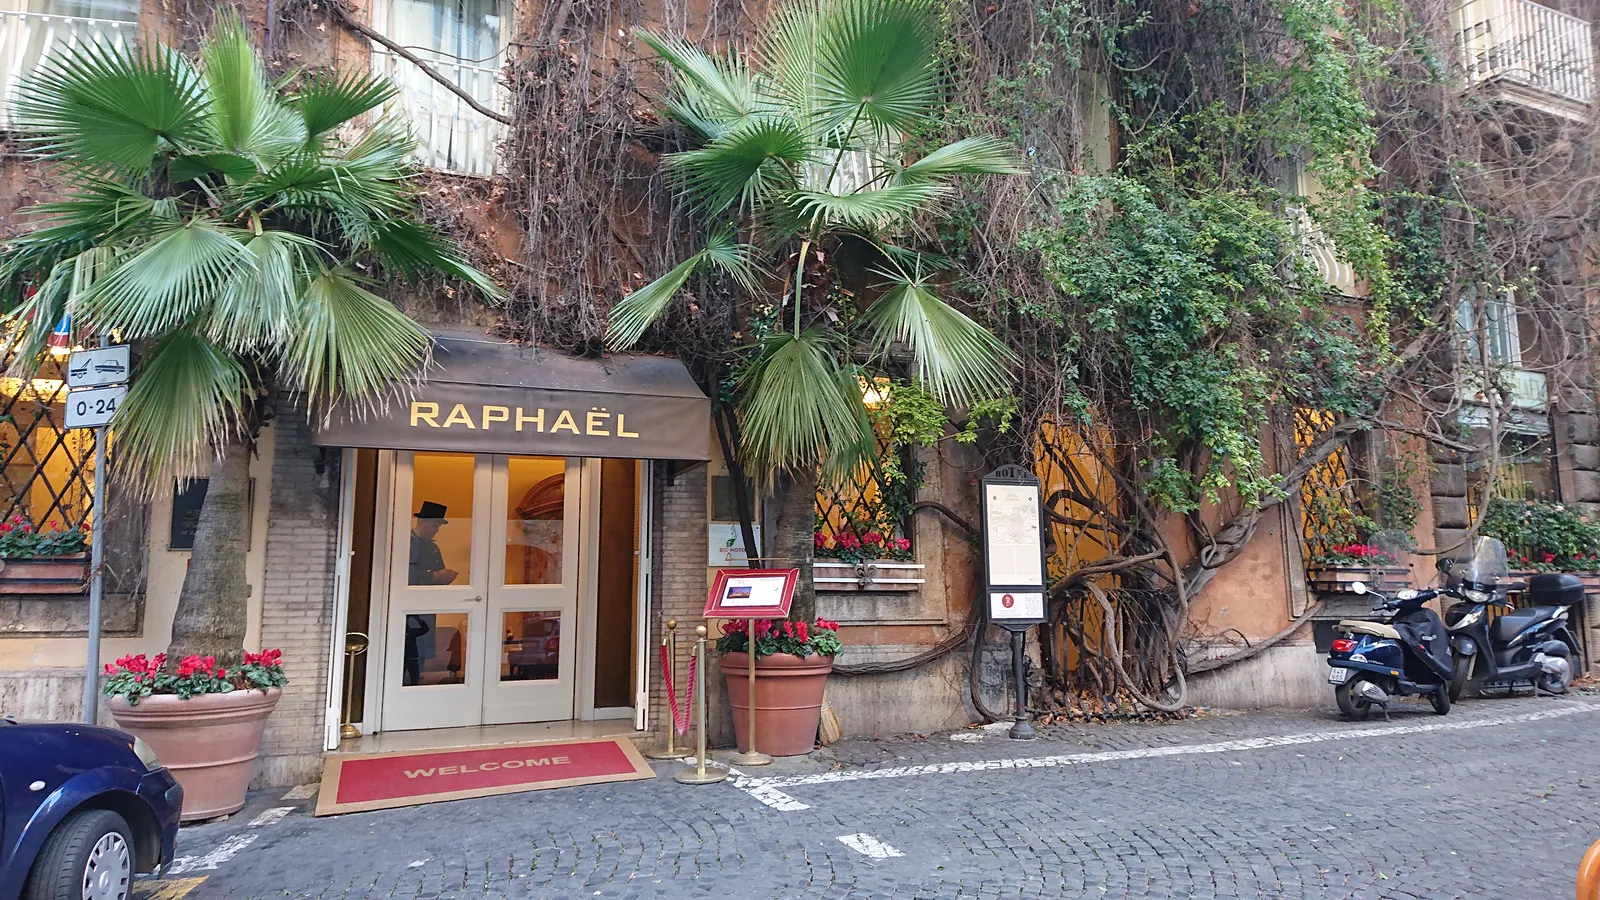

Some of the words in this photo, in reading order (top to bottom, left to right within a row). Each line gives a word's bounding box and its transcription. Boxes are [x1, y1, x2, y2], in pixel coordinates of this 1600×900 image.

[77, 398, 116, 416] 0-24
[410, 401, 639, 438] RAPHAËL
[403, 756, 572, 779] WELCOME
